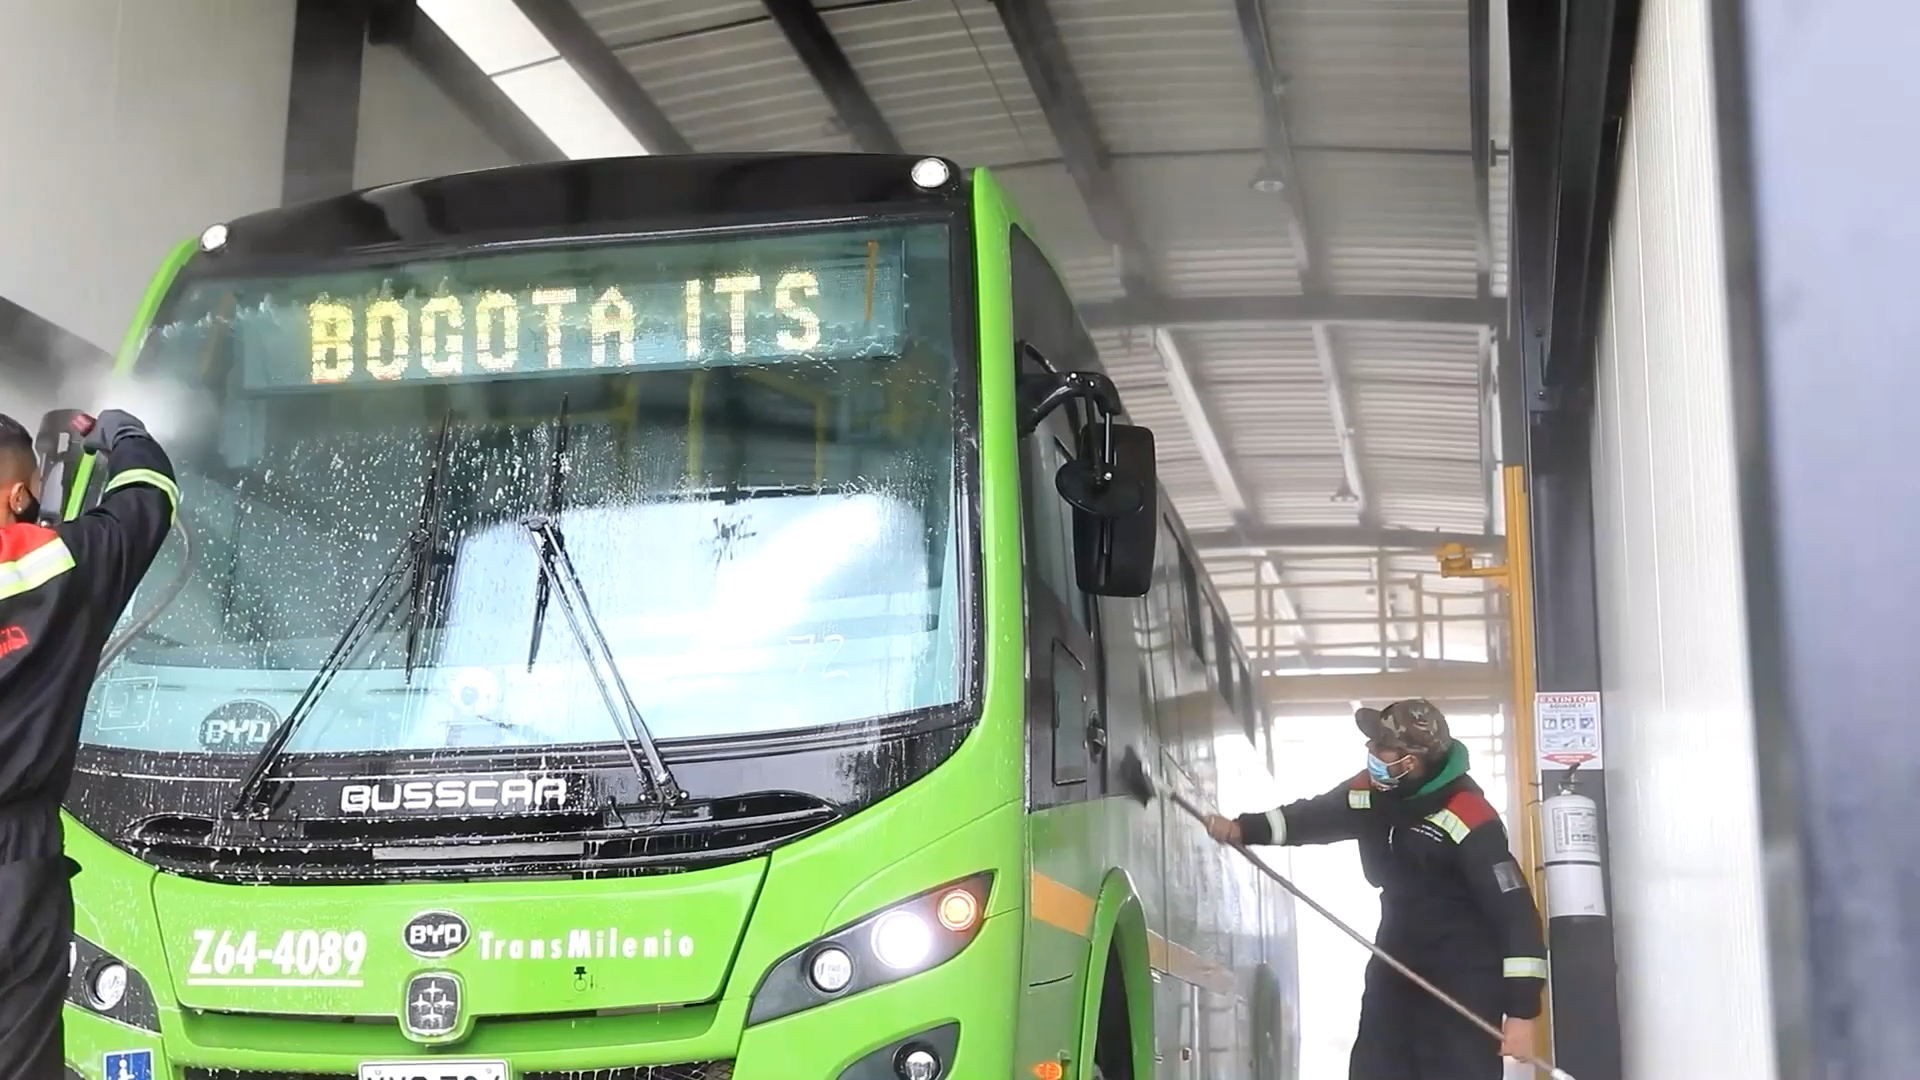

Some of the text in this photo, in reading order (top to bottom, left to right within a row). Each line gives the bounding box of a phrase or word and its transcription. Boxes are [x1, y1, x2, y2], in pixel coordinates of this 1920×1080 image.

[308, 270, 822, 383] BOGOTA ITS
[1539, 694, 1595, 704] EXTINTOR
[204, 718, 271, 744] BYD
[340, 779, 566, 814] BUSSCAR
[188, 929, 368, 976] Z64-4089
[409, 924, 463, 947] BYD
[479, 927, 695, 961] TransMilenio
